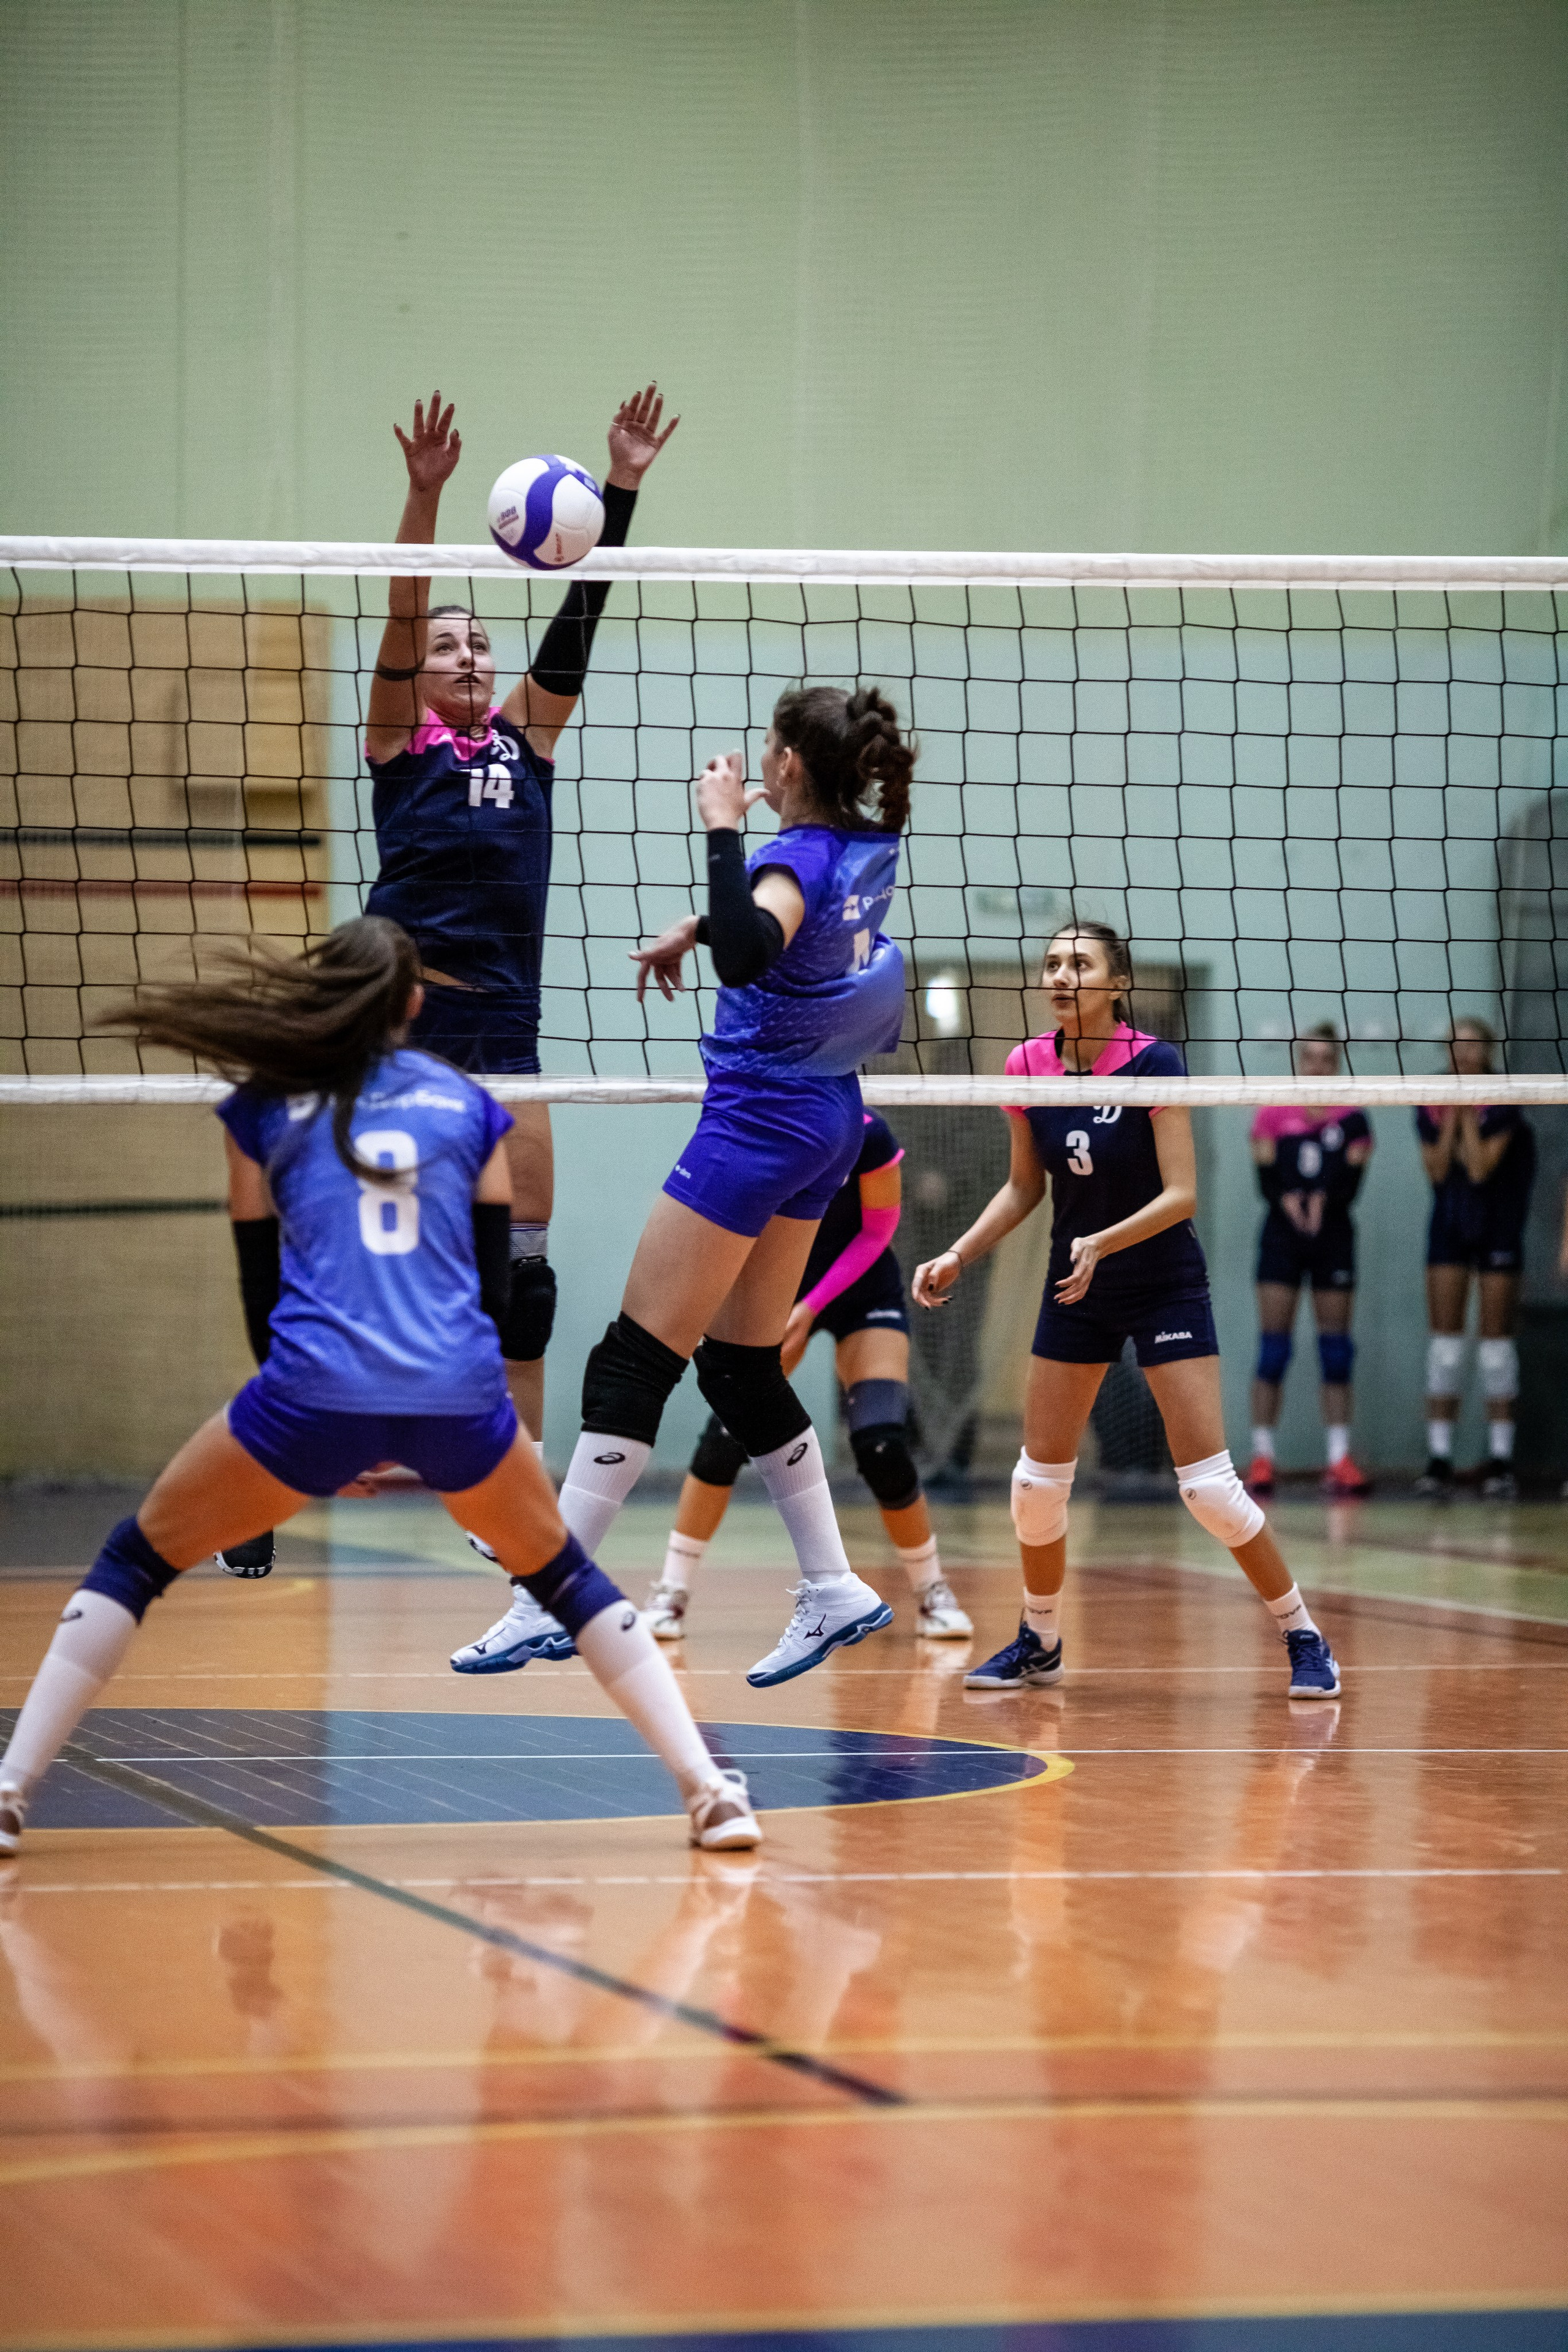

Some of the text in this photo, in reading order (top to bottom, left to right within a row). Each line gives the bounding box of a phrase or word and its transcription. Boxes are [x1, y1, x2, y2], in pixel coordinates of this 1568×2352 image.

[461, 763, 514, 809] 14
[1066, 1130, 1093, 1175] 3
[354, 1130, 419, 1255] 8
